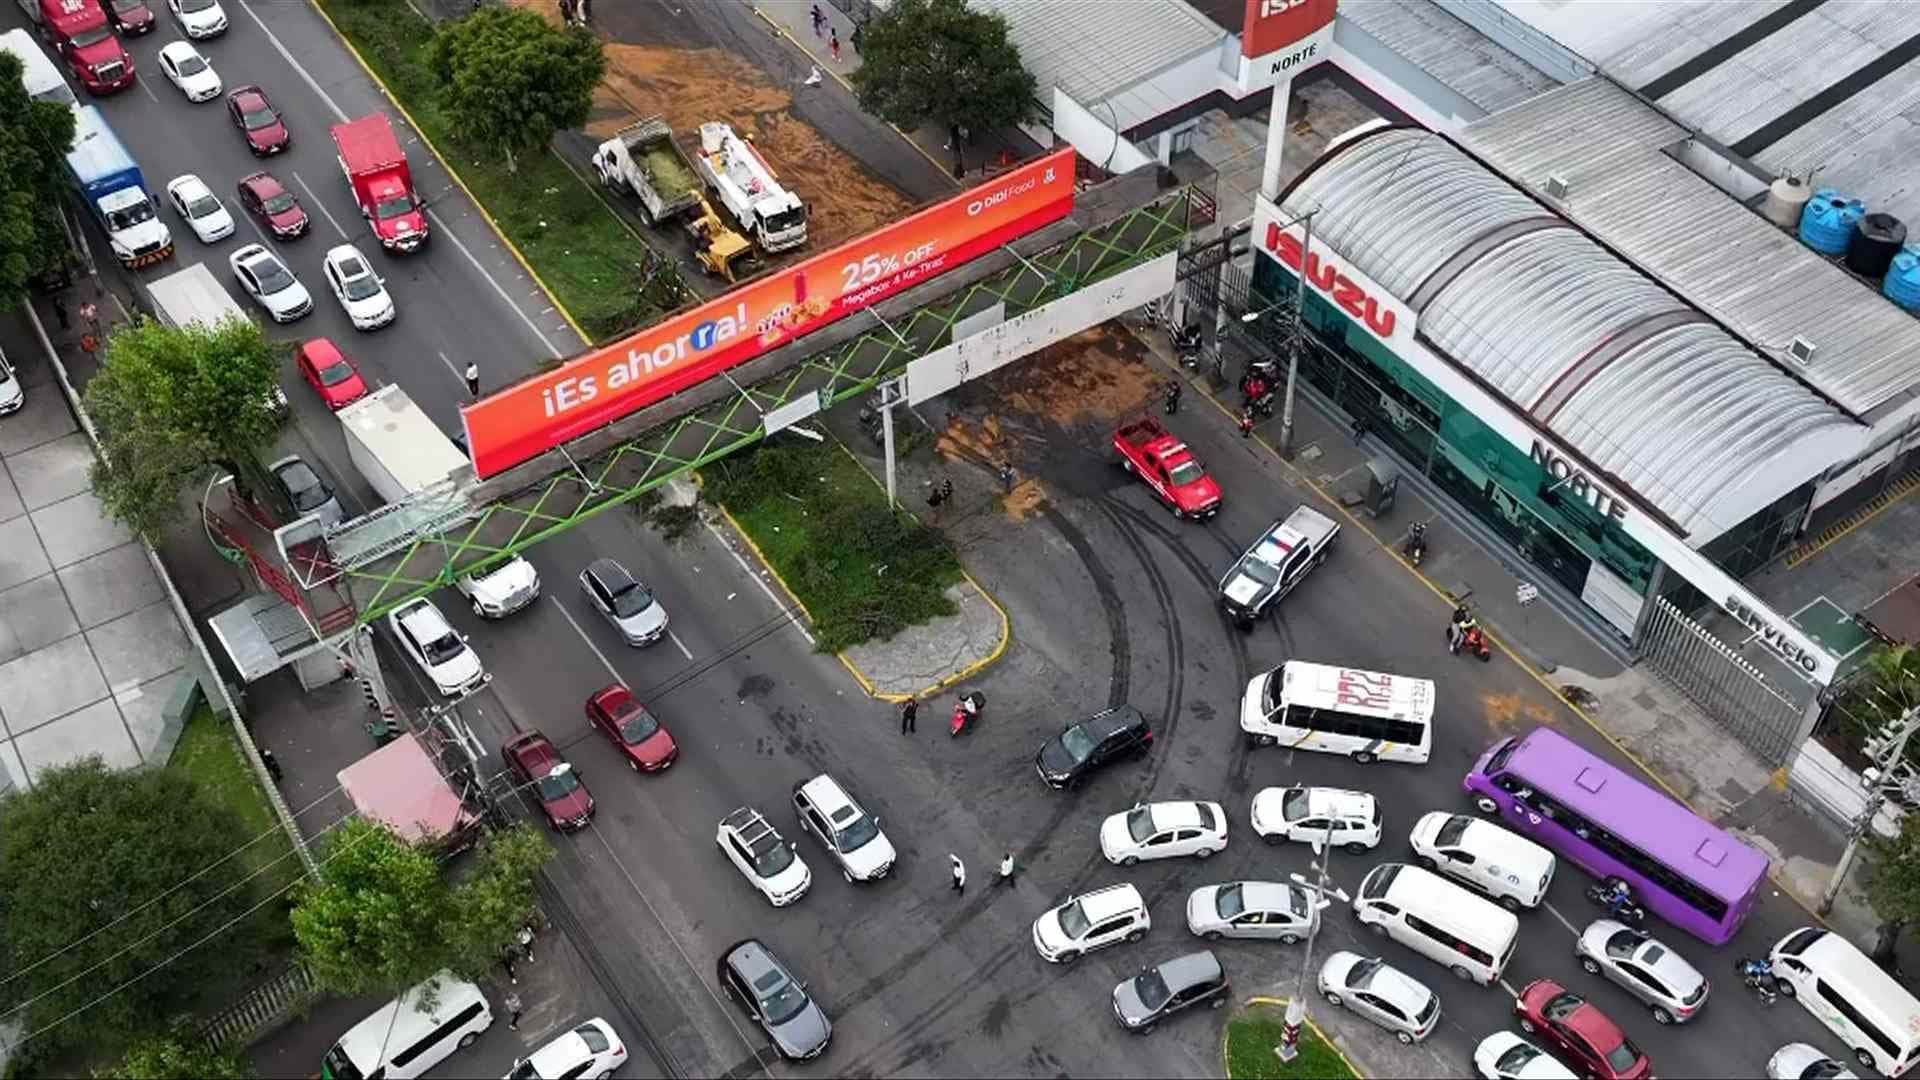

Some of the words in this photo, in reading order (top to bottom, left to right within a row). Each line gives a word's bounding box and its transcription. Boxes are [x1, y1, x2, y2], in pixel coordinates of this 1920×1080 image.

[1271, 42, 1317, 74] NORTE
[1008, 176, 1035, 200] Food
[841, 252, 900, 294] 25%
[1266, 221, 1396, 338] ISUZU
[607, 303, 748, 389] ahorra!
[1529, 440, 1629, 528] NORTE
[1724, 594, 1819, 673] SERVICIO
